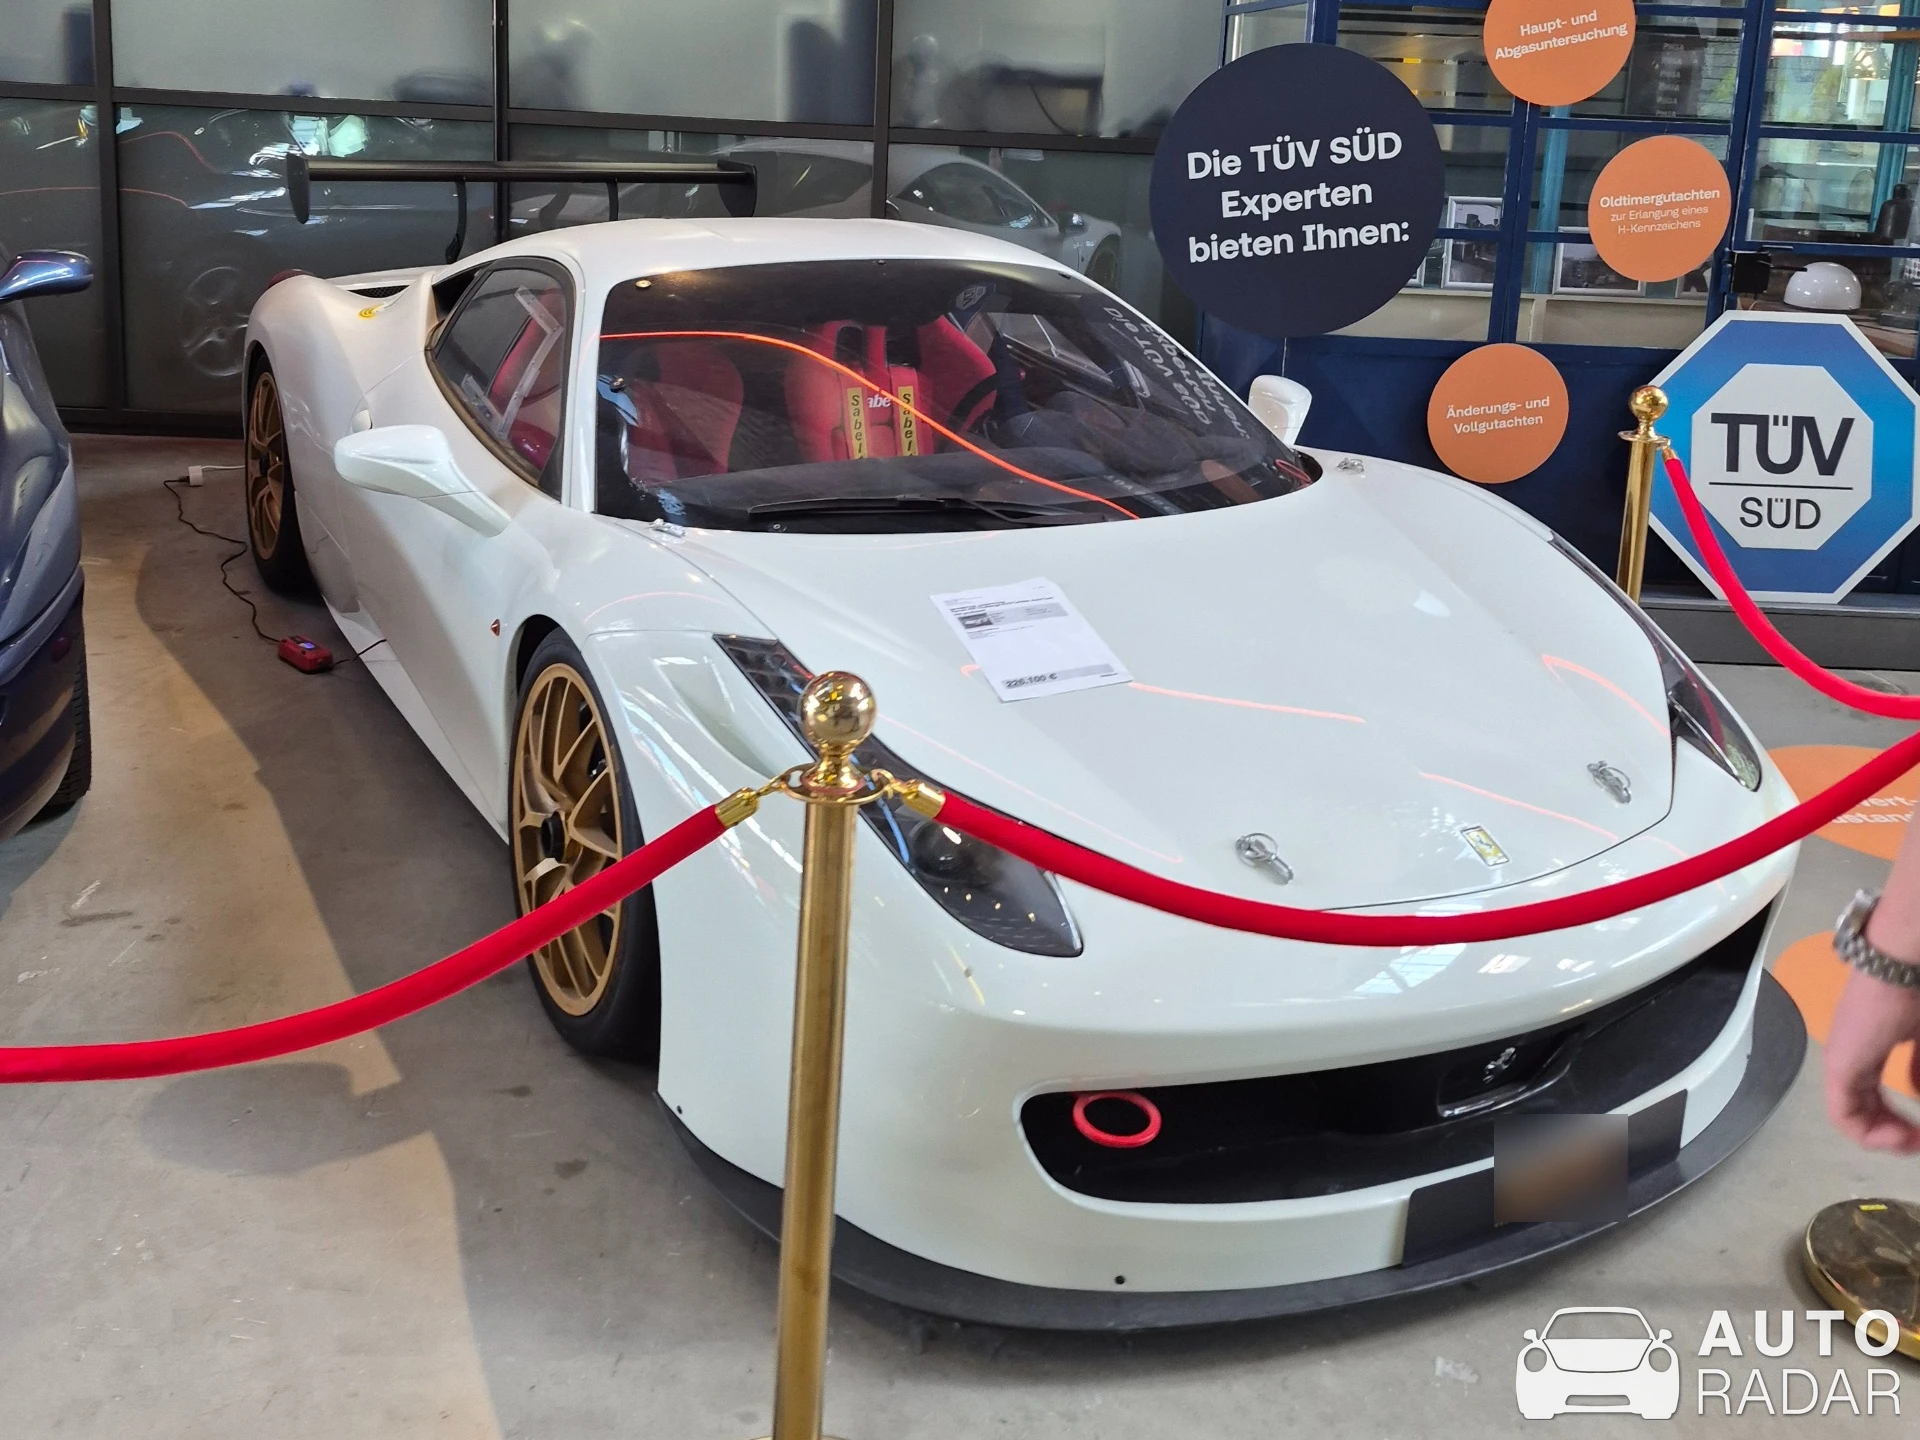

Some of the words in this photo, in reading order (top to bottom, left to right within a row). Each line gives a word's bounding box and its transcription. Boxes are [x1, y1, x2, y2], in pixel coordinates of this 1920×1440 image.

[1520, 18, 1567, 36] Haupt-
[1571, 10, 1597, 25] und
[1495, 23, 1628, 60] Abgasuntersuchung
[1187, 149, 1242, 179] Die
[1250, 135, 1320, 172] TÜV
[1329, 127, 1402, 164] SÜD
[1221, 183, 1372, 221] Experten
[1600, 189, 1720, 208] Oldtimergutachten
[1610, 213, 1626, 222] zur
[1629, 208, 1680, 220] Erlangung
[1681, 205, 1709, 215] eines
[1618, 220, 1701, 234] H-Kennzeichens
[1189, 231, 1294, 263] bieten
[1302, 222, 1409, 252] Ihnen:
[1446, 402, 1522, 419] Änderungs-
[1525, 396, 1550, 409] und
[1454, 415, 1543, 434] Vollgutachten
[1711, 413, 1855, 476] TÜV
[1739, 497, 1821, 529] SÜD
